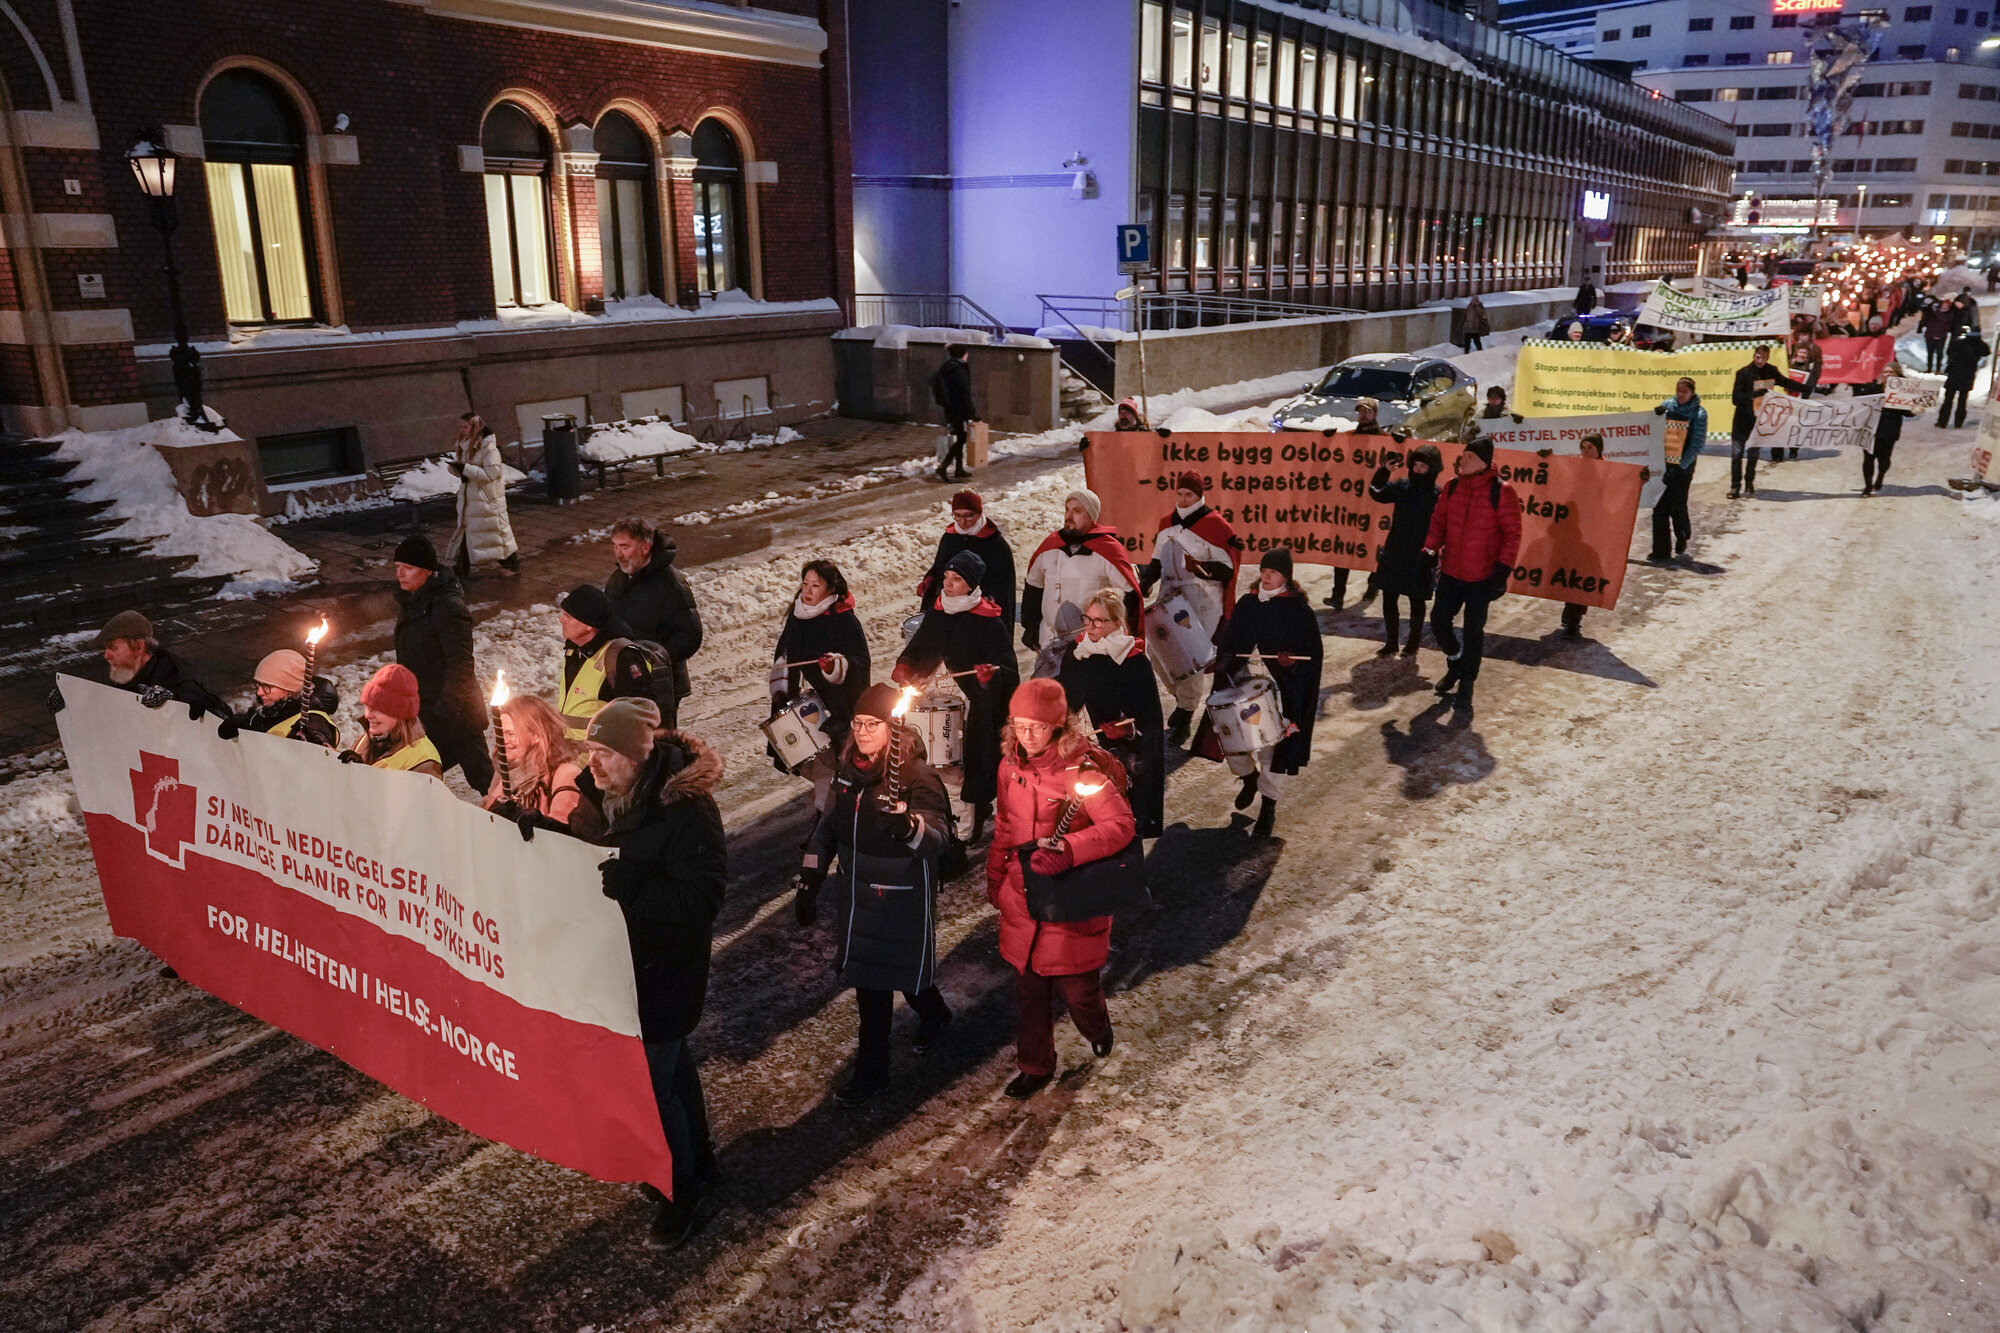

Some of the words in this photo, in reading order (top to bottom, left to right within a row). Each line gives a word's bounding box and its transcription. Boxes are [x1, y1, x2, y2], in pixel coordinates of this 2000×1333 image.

[1774, 0, 1842, 11] Scandic
[1124, 229, 1142, 258] P
[1535, 362, 1558, 372] Stopp
[1561, 365, 1626, 376] sentraliseringen
[1638, 368, 1708, 377] helsetjenestene
[1532, 399, 1545, 408] alle
[1547, 401, 1570, 410] andre
[1572, 403, 1599, 411] steder
[1533, 386, 1617, 398] Prestisjeprosjektene
[1623, 391, 1640, 399] Oslo
[1642, 391, 1673, 400] fortren
[1519, 429, 1557, 442] STJEL
[1162, 442, 1210, 463] Ikke
[1217, 441, 1273, 465] bygg
[1281, 444, 1344, 463] Oslos
[1156, 470, 1213, 492] sie
[1221, 470, 1332, 495] kapasitet
[1340, 477, 1364, 497] og
[1499, 462, 1549, 486] små
[1242, 505, 1268, 524] til
[1276, 505, 1371, 532] utvikling
[1238, 533, 1368, 559] stersykehus
[1550, 568, 1611, 594] Aker
[207, 795, 225, 819] SI
[231, 802, 254, 832] NEI
[254, 817, 281, 846] TIL
[435, 883, 465, 928] KUTT
[472, 910, 500, 945] OG
[206, 823, 277, 872] DÅRLIGE
[356, 883, 388, 920] FOR
[433, 917, 505, 980] SYKEHUS
[207, 904, 249, 943] FOR
[255, 921, 357, 994] HELHETEN
[362, 972, 368, 999] I
[375, 977, 520, 1081] HELSE-NORGE
